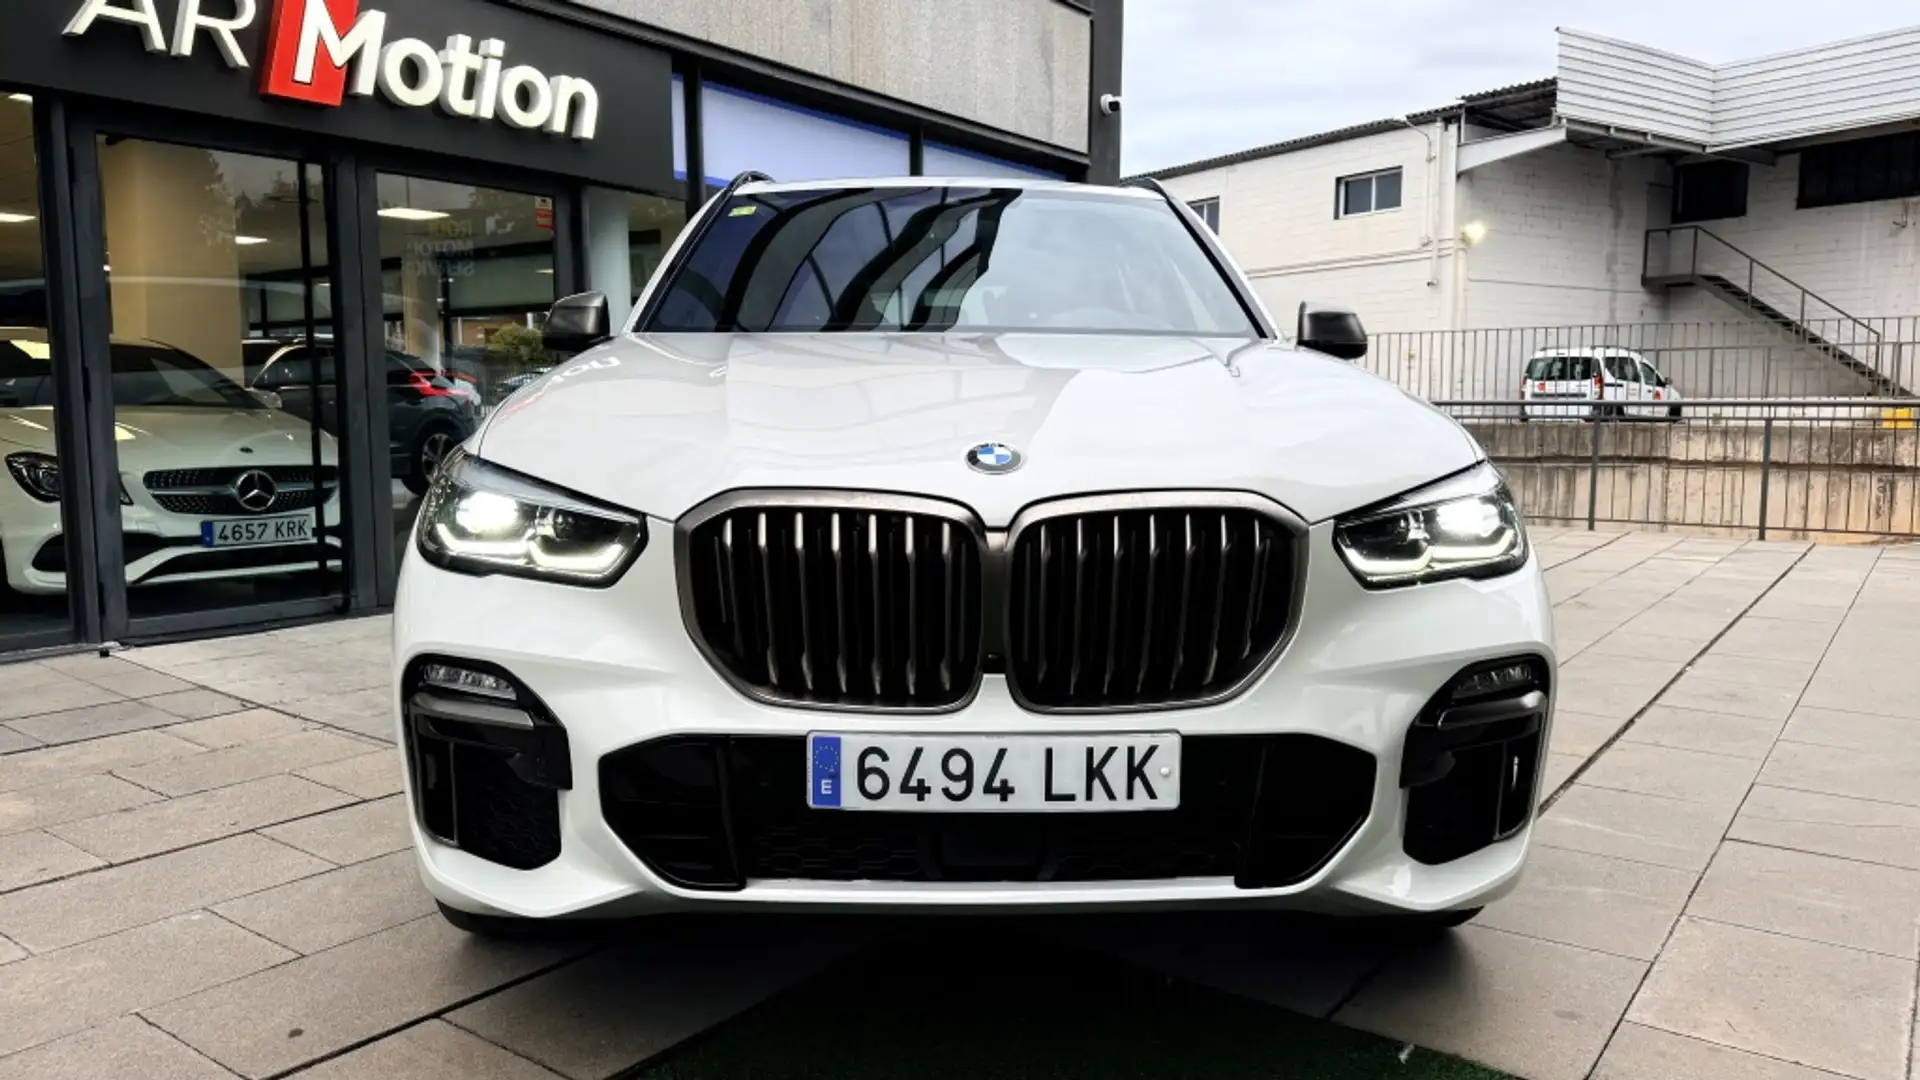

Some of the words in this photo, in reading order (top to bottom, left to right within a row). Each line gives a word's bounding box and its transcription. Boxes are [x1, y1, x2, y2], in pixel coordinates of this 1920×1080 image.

[292, 0, 599, 140] Motion
[218, 522, 268, 541] 4657
[275, 520, 307, 537] KRK
[821, 779, 833, 795] E
[857, 746, 1015, 801] 6494
[1044, 745, 1159, 801] LKK
